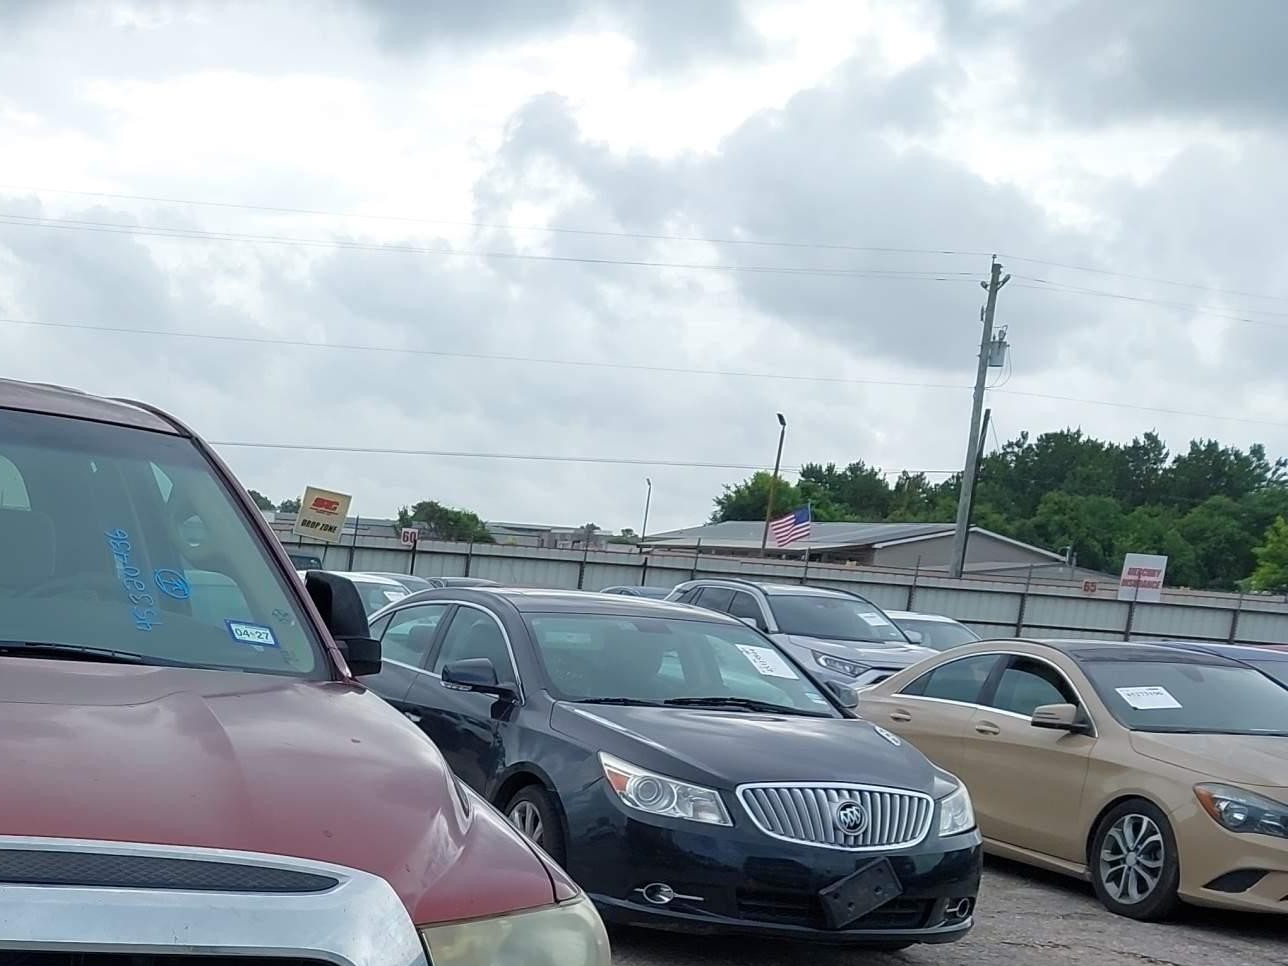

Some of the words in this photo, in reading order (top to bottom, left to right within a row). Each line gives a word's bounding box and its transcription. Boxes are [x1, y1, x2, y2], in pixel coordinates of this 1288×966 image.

[301, 519, 320, 528] DROP
[320, 523, 337, 533] ZONE
[402, 531, 416, 543] 60
[234, 628, 250, 637] 04
[255, 630, 269, 640] 27
